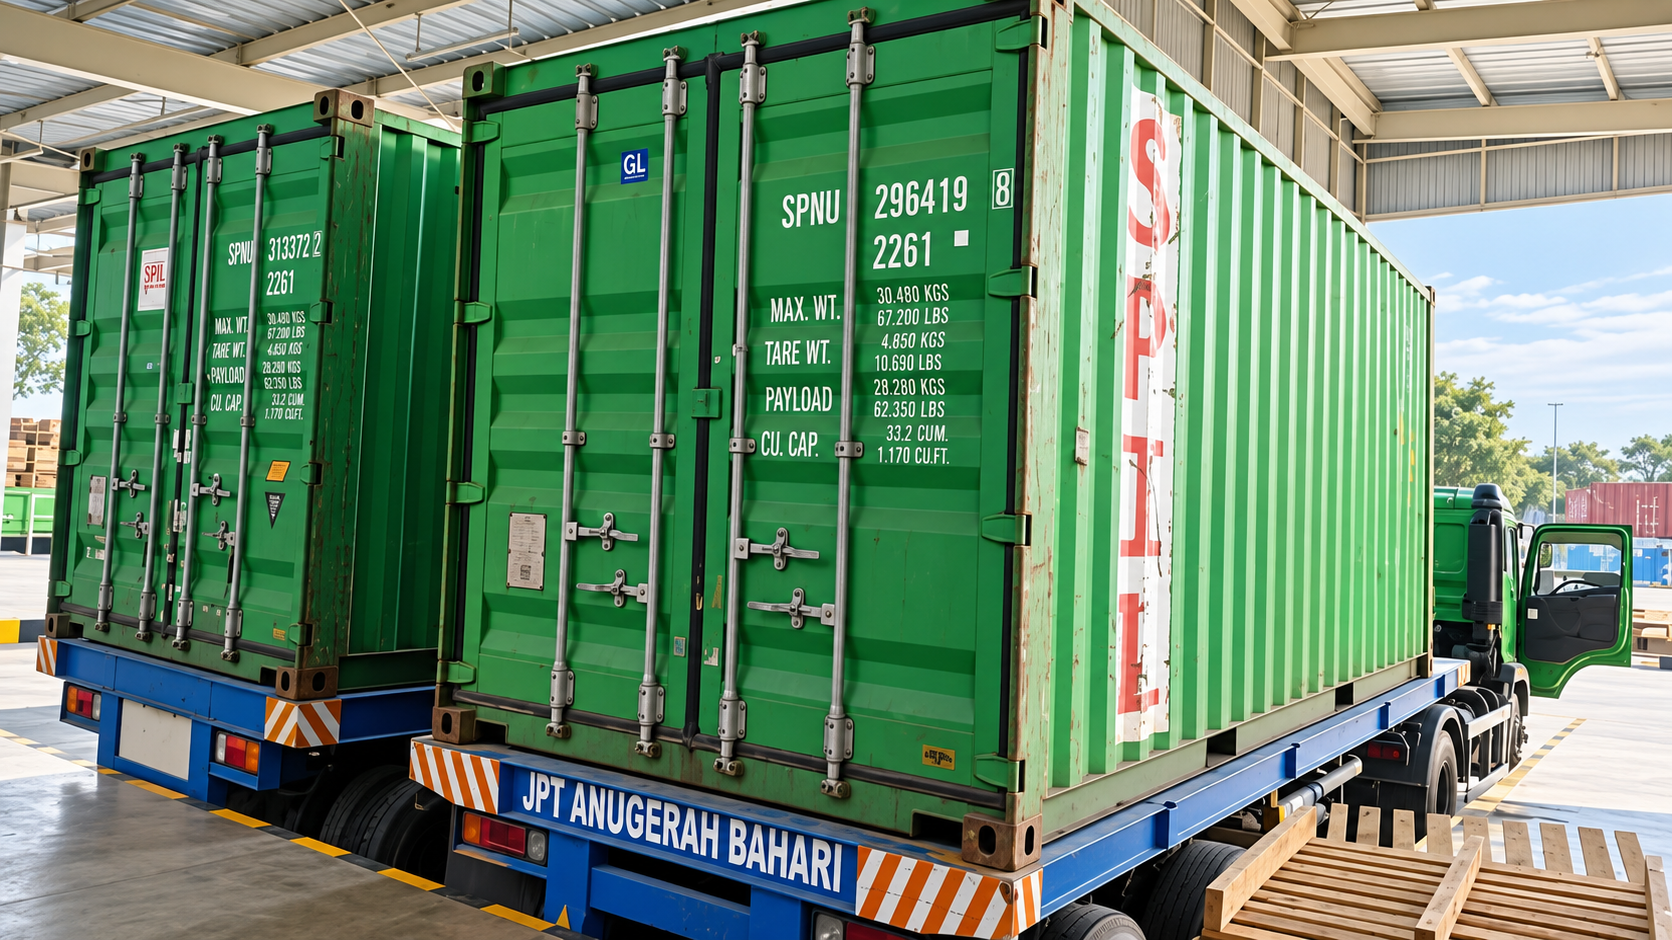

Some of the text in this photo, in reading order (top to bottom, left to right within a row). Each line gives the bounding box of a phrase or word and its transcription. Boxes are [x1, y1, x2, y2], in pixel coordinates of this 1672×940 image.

[623, 152, 646, 175] GL
[781, 170, 1011, 229] SPNU 296419 8
[228, 231, 321, 266] SPNU 313372 2
[872, 231, 931, 270] 2261
[144, 263, 166, 284] SPIL
[266, 269, 295, 296] 2261
[876, 283, 950, 305] 30.480 KGS
[770, 294, 841, 323] MAX. WT.
[877, 306, 949, 327] 67.200 LBS
[214, 316, 249, 335] MAX. WT.
[291, 326, 306, 339] LBS
[212, 341, 246, 359] TARE WT.
[881, 331, 946, 350] 4.850 KGS
[764, 339, 831, 366] TARE WT.
[874, 353, 942, 372] 10.690 LBS
[211, 366, 245, 384] PAYLOAD
[873, 377, 946, 396] 28.280 KGS
[210, 393, 242, 412] CU. CAP.
[765, 386, 833, 412] PAYLOAD
[873, 400, 946, 418] 62.350 LBS
[1117, 117, 1171, 715] SPIL
[886, 424, 949, 442] 33.2 CUM.
[761, 430, 819, 458] CU. CAP.
[877, 446, 950, 465] 1.170 CU.FT.
[522, 771, 843, 893] JPT ANUGERAH BAHARI
